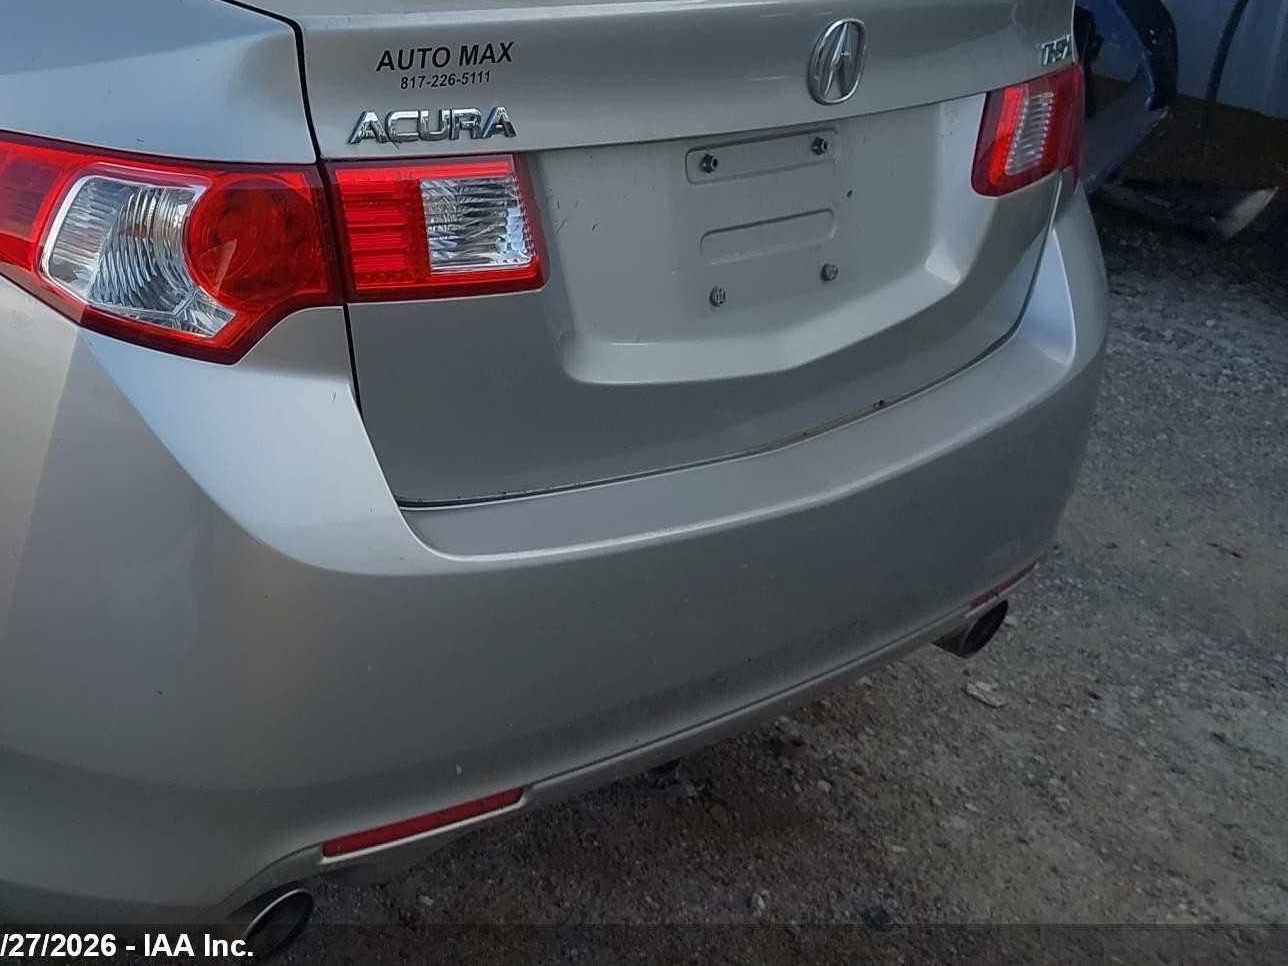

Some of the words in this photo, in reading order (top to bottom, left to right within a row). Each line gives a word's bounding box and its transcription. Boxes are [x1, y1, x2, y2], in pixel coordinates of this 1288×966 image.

[376, 47, 451, 71] AUTO
[459, 41, 514, 65] MAX
[400, 70, 491, 90] 817-226-5111
[348, 106, 518, 144] ACURA
